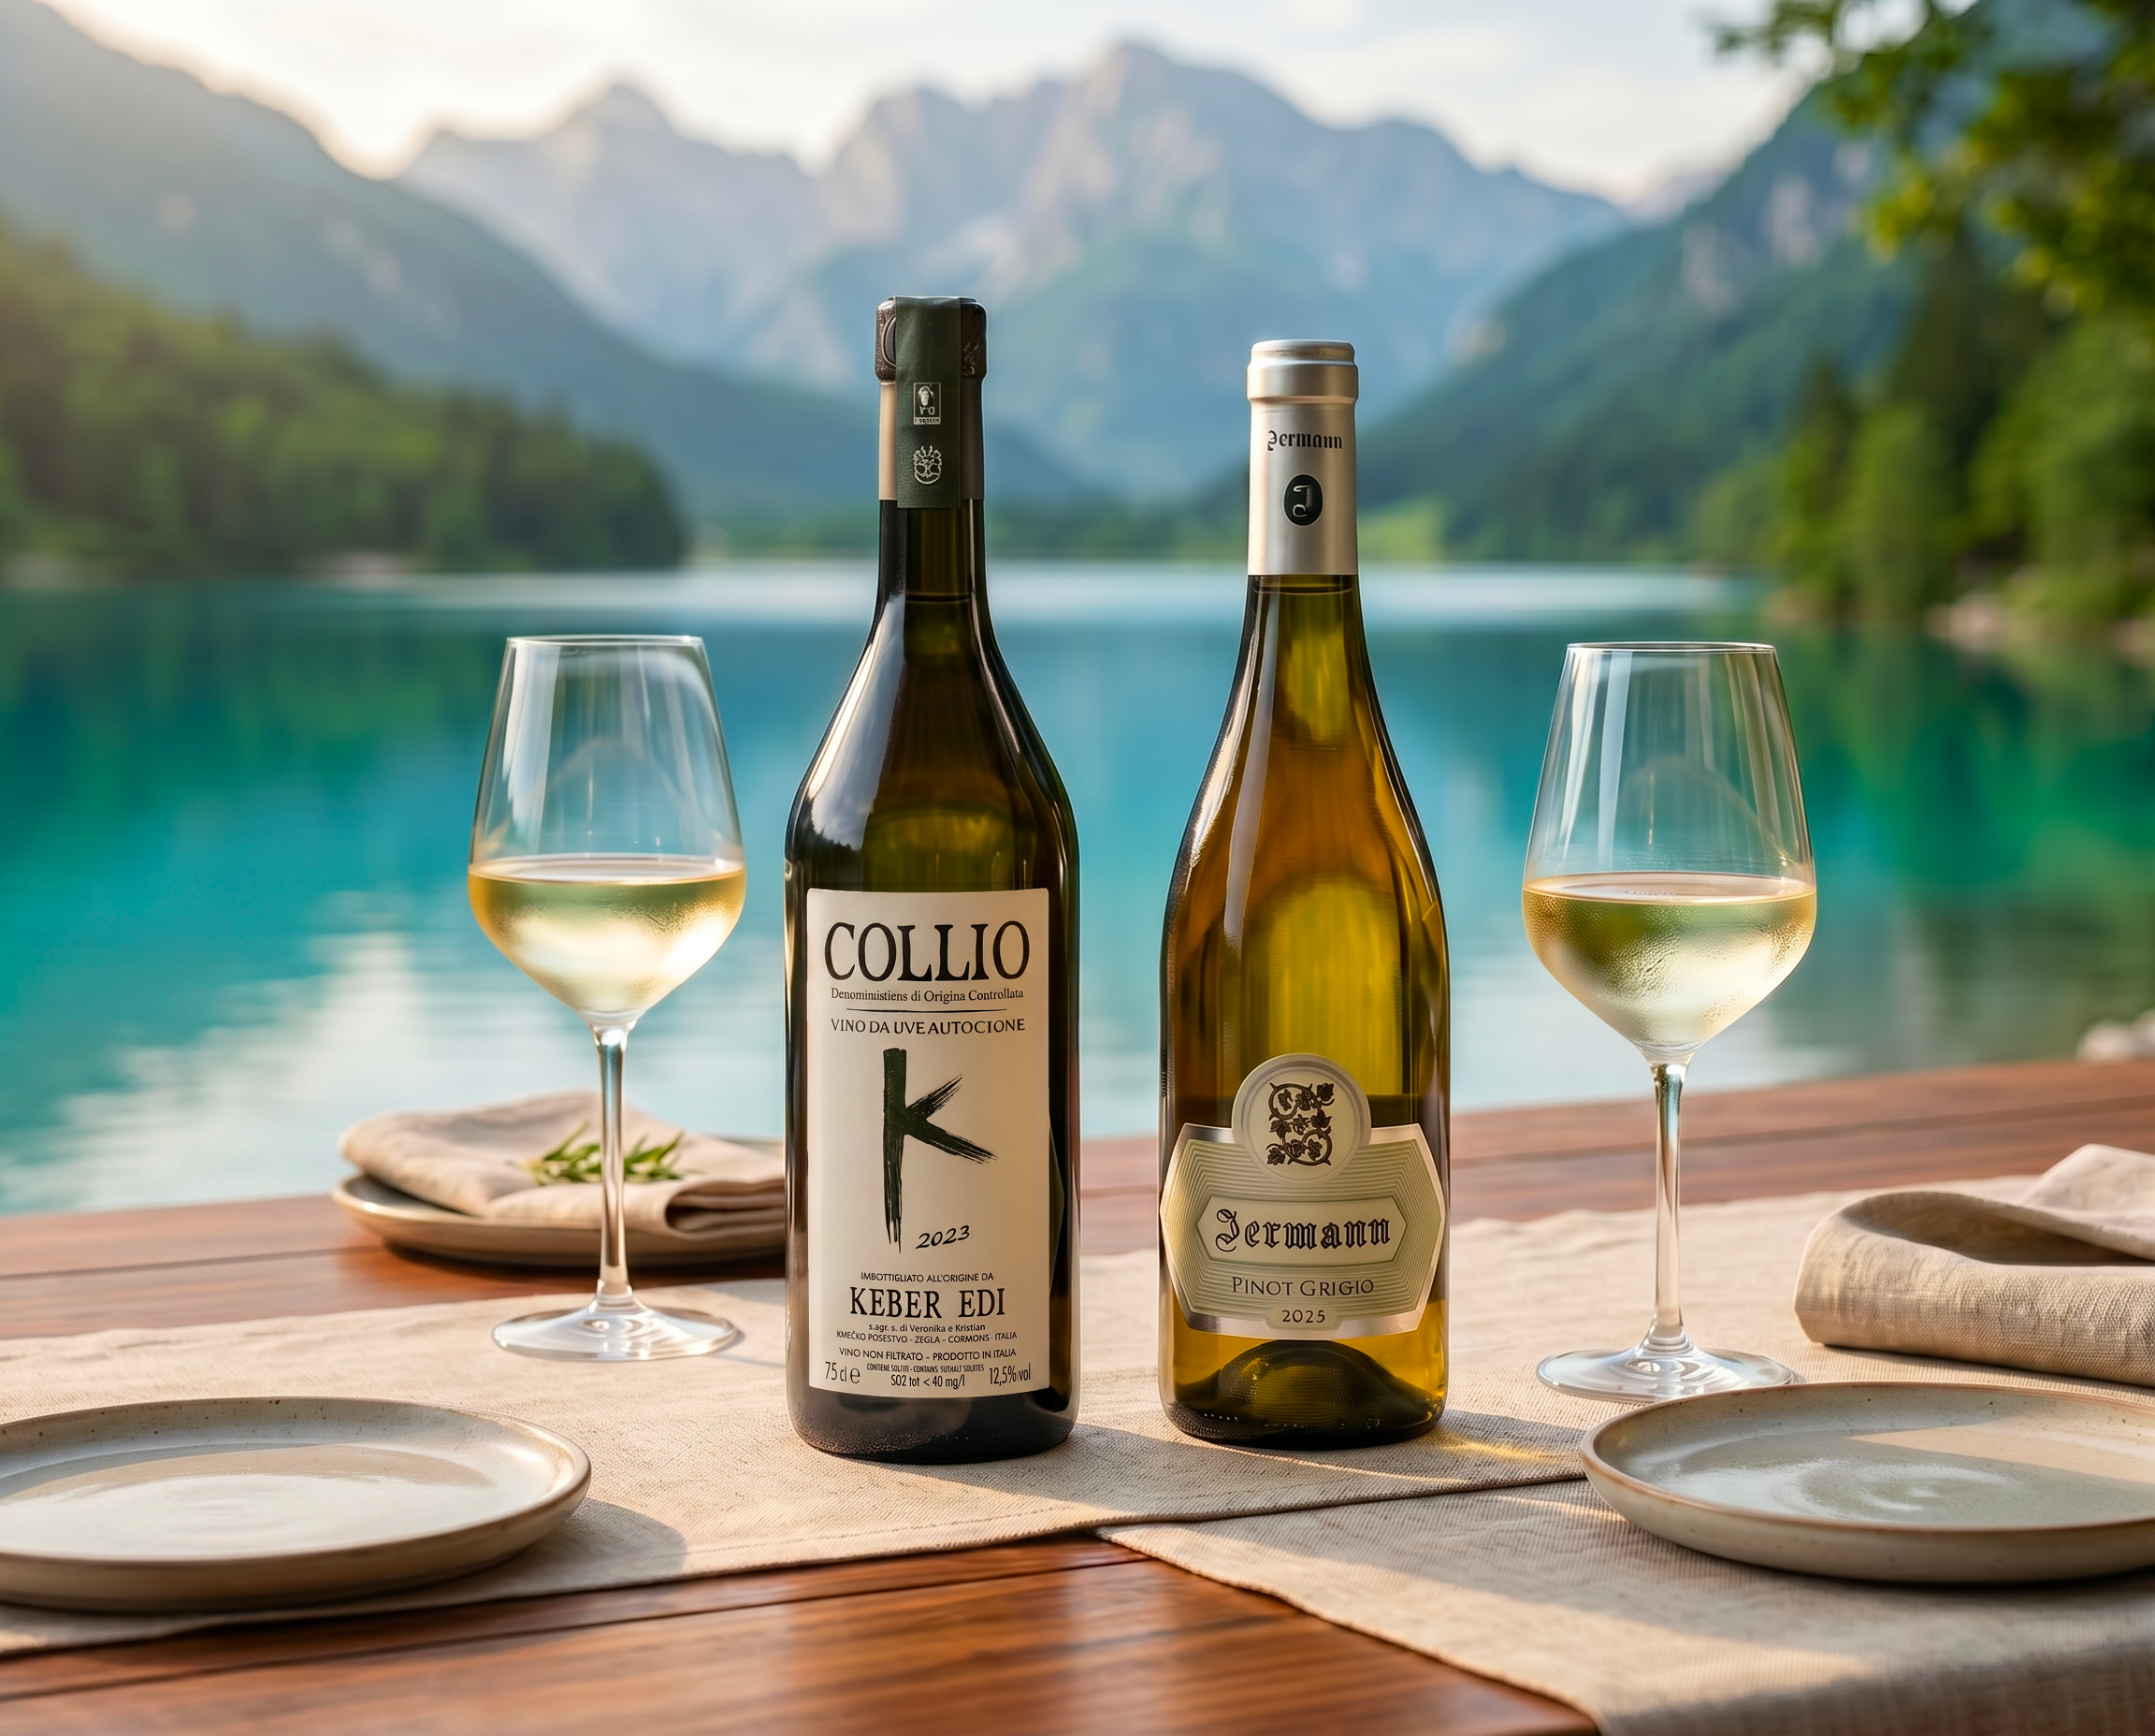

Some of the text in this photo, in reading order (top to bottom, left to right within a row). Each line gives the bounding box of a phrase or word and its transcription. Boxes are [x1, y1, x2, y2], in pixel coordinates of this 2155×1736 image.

[825, 920, 1030, 981] COLLIO
[911, 991, 920, 1001] di
[924, 991, 965, 1005] Origina
[969, 989, 1023, 1001] Controllata
[832, 1019, 1025, 1034] VINO DA UVE AUTOCIONE
[882, 1048, 998, 1253] K
[916, 1225, 969, 1249] 2023
[1216, 1209, 1390, 1251] Jermann
[861, 1272, 994, 1282] IMBOTTIGLIATO ALL'ORIGINE DA
[1232, 1277, 1374, 1295] PINOT GRIGIO
[850, 1287, 1005, 1318] KEBER EDI
[1282, 1309, 1325, 1323] 2025
[837, 1331, 866, 1340] KMEČKO
[868, 1334, 907, 1342] POSESTVO
[948, 1334, 990, 1343] CORMONS
[995, 1332, 1017, 1340] ITALIA
[839, 1348, 861, 1357] VINO
[863, 1350, 883, 1358] NON
[887, 1352, 923, 1361] FILTRATO
[933, 1352, 979, 1361] PRODOTTO
[983, 1351, 991, 1359] IN
[994, 1349, 1016, 1358] ITALIA
[825, 1362, 837, 1380] 75
[990, 1363, 1031, 1386] 12,5% vol
[909, 1377, 919, 1386] tot
[933, 1376, 943, 1387] 40
[946, 1374, 964, 1390] mg/l
